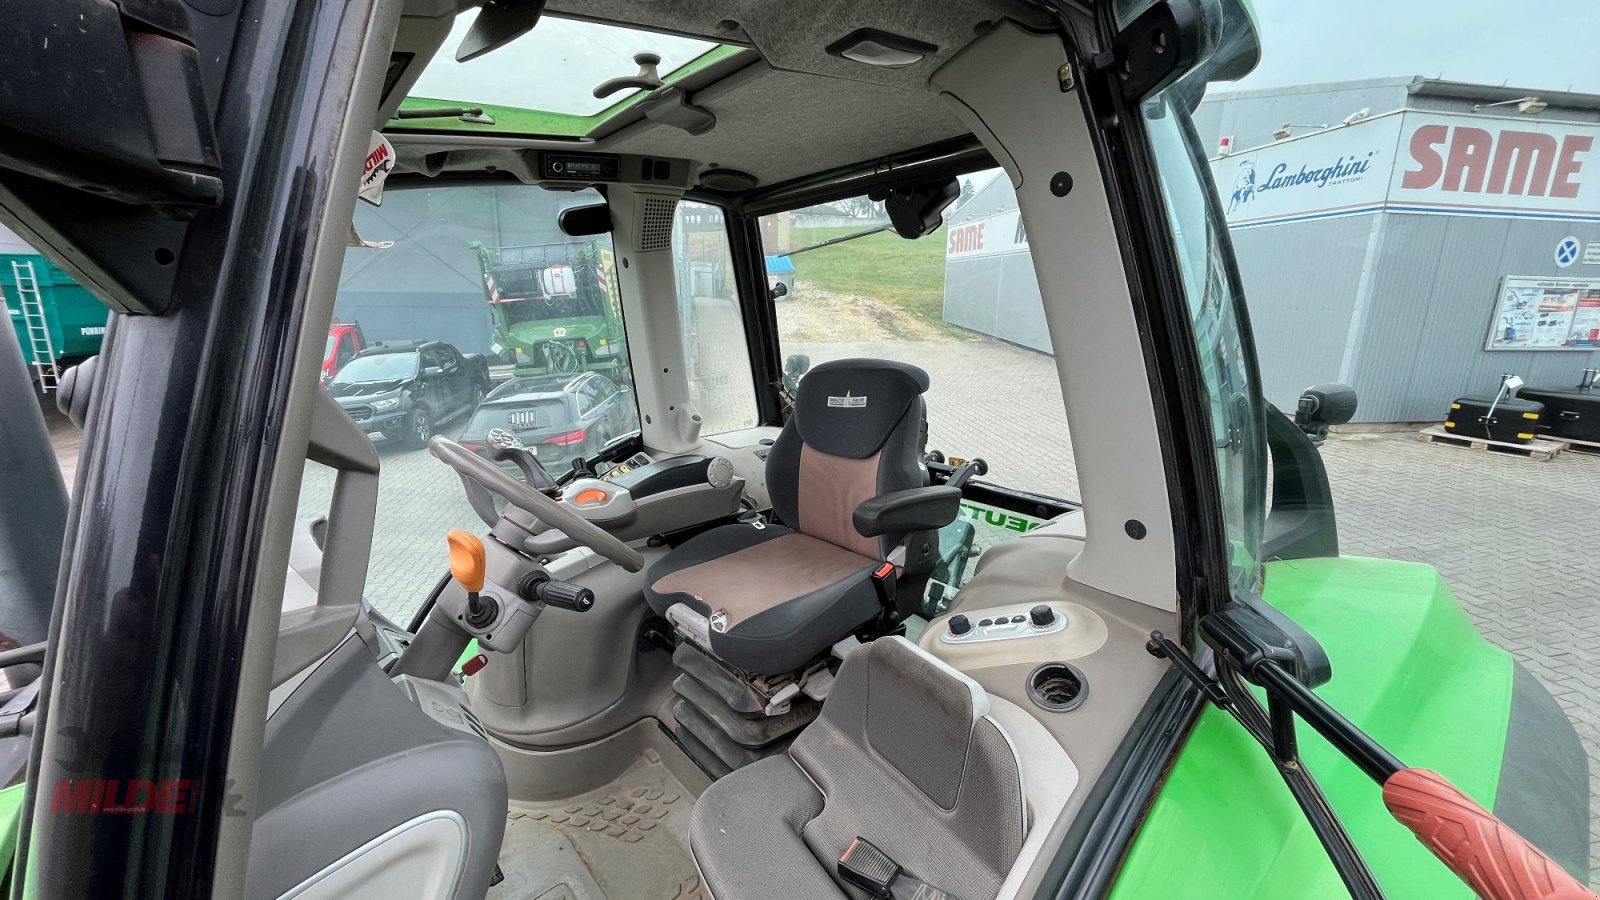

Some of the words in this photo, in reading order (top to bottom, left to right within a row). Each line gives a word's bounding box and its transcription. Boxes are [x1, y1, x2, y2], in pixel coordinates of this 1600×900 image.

[363, 143, 389, 176] MILD
[1257, 152, 1373, 193] Lamborghini
[1401, 124, 1595, 198] SAME
[1328, 176, 1364, 187] TRATTORI
[949, 222, 985, 254] SAME
